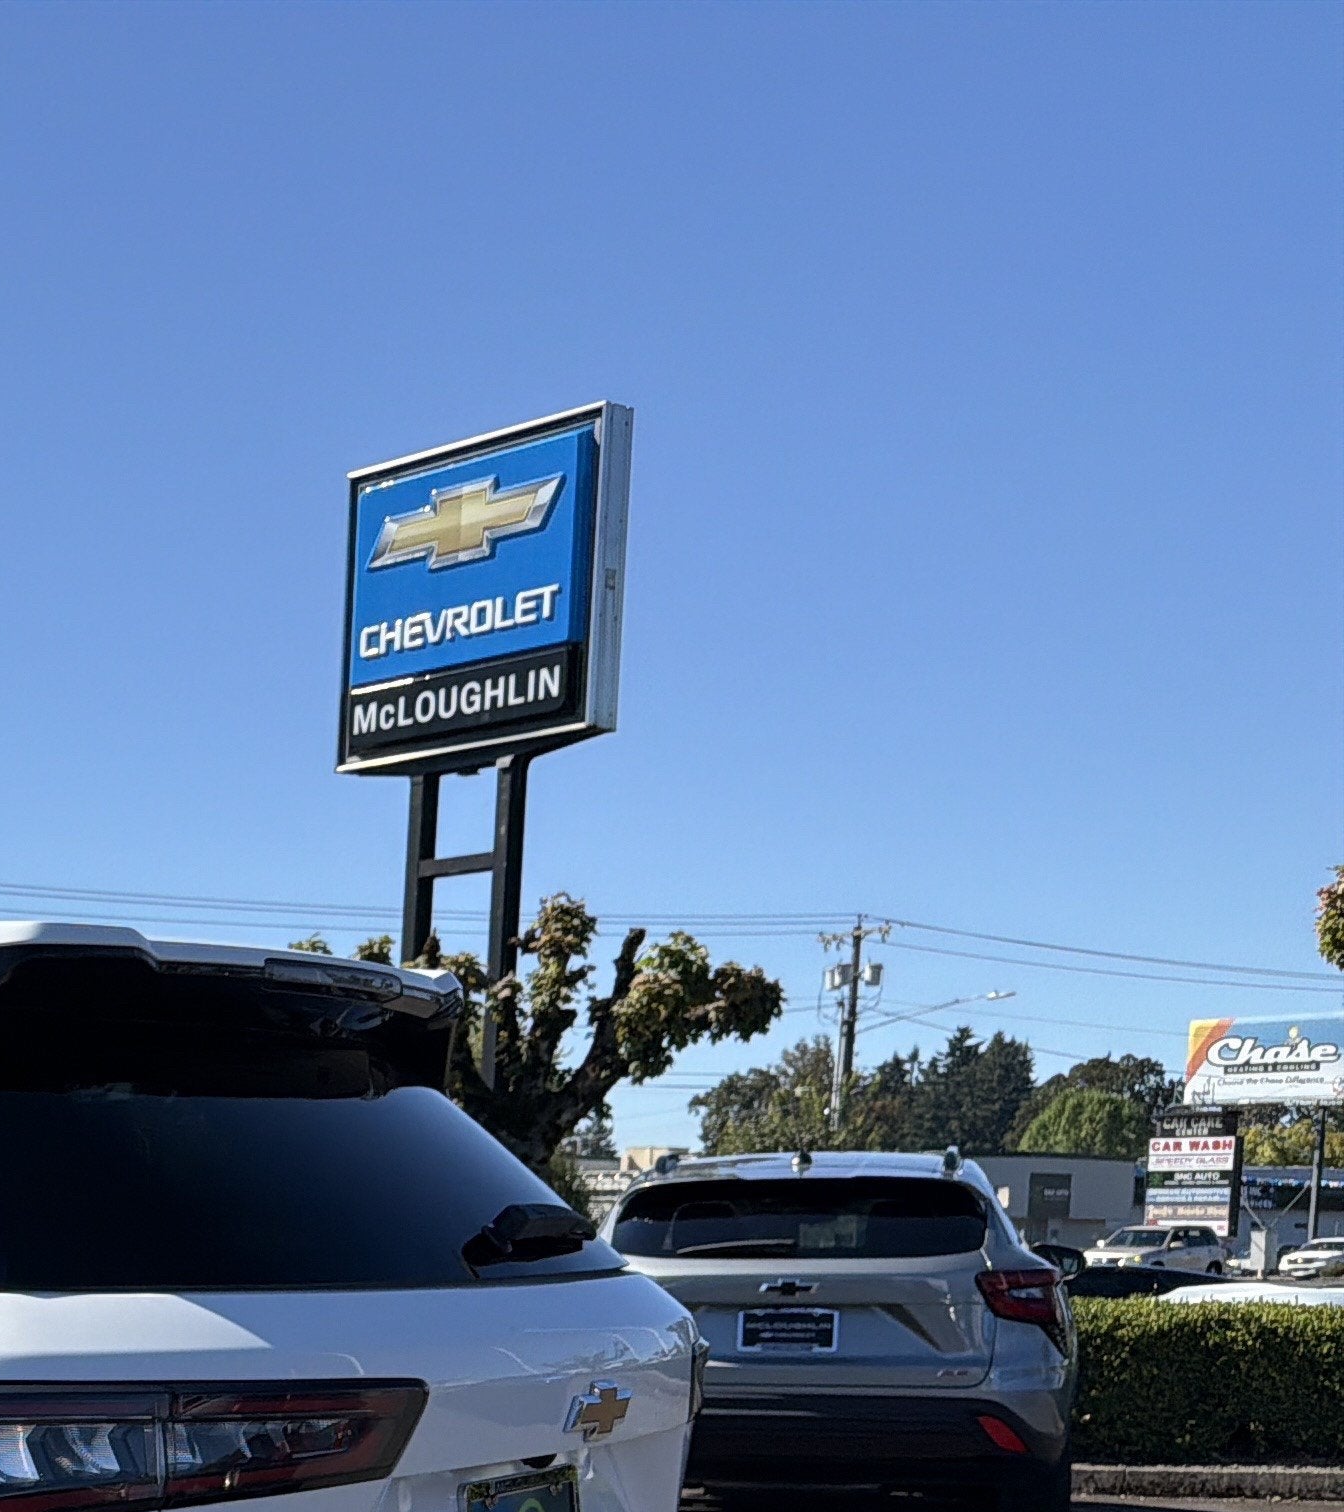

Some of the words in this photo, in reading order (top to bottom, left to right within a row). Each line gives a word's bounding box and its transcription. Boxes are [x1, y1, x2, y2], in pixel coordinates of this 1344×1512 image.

[359, 583, 561, 661] CHEVROLET
[352, 664, 561, 736] McLOUGHLIN
[1207, 1035, 1340, 1066] Chase
[1151, 1141, 1183, 1152] CAR
[1188, 1139, 1233, 1151] WASH
